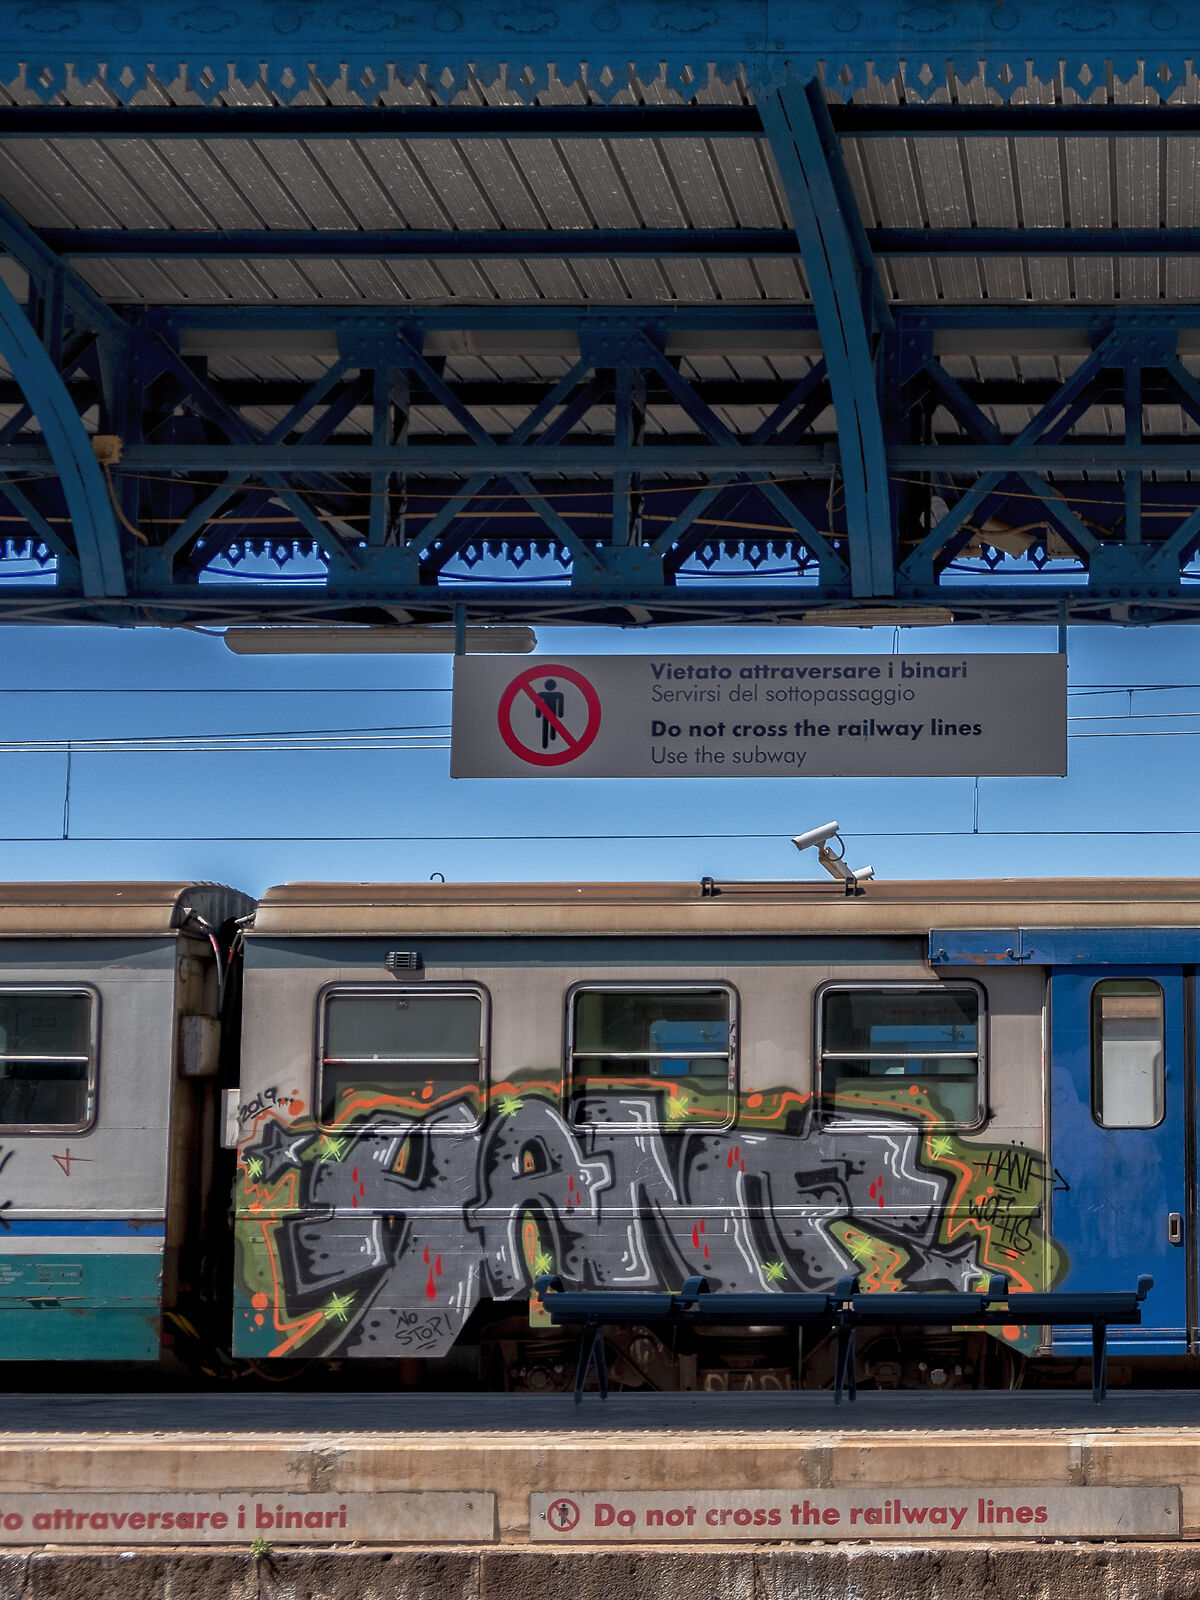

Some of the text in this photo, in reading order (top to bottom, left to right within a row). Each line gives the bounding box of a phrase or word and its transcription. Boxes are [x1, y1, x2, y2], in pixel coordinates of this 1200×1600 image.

[650, 660, 967, 680] Vietato attraversare i binari
[650, 683, 916, 706] Servirsi del sottopassaggio
[650, 718, 983, 742] Do not cross the railway lines
[650, 744, 807, 767] Use the subway
[0, 1503, 347, 1531] o attraversare i binari
[594, 1498, 1048, 1530] Do not cross the railway lines
